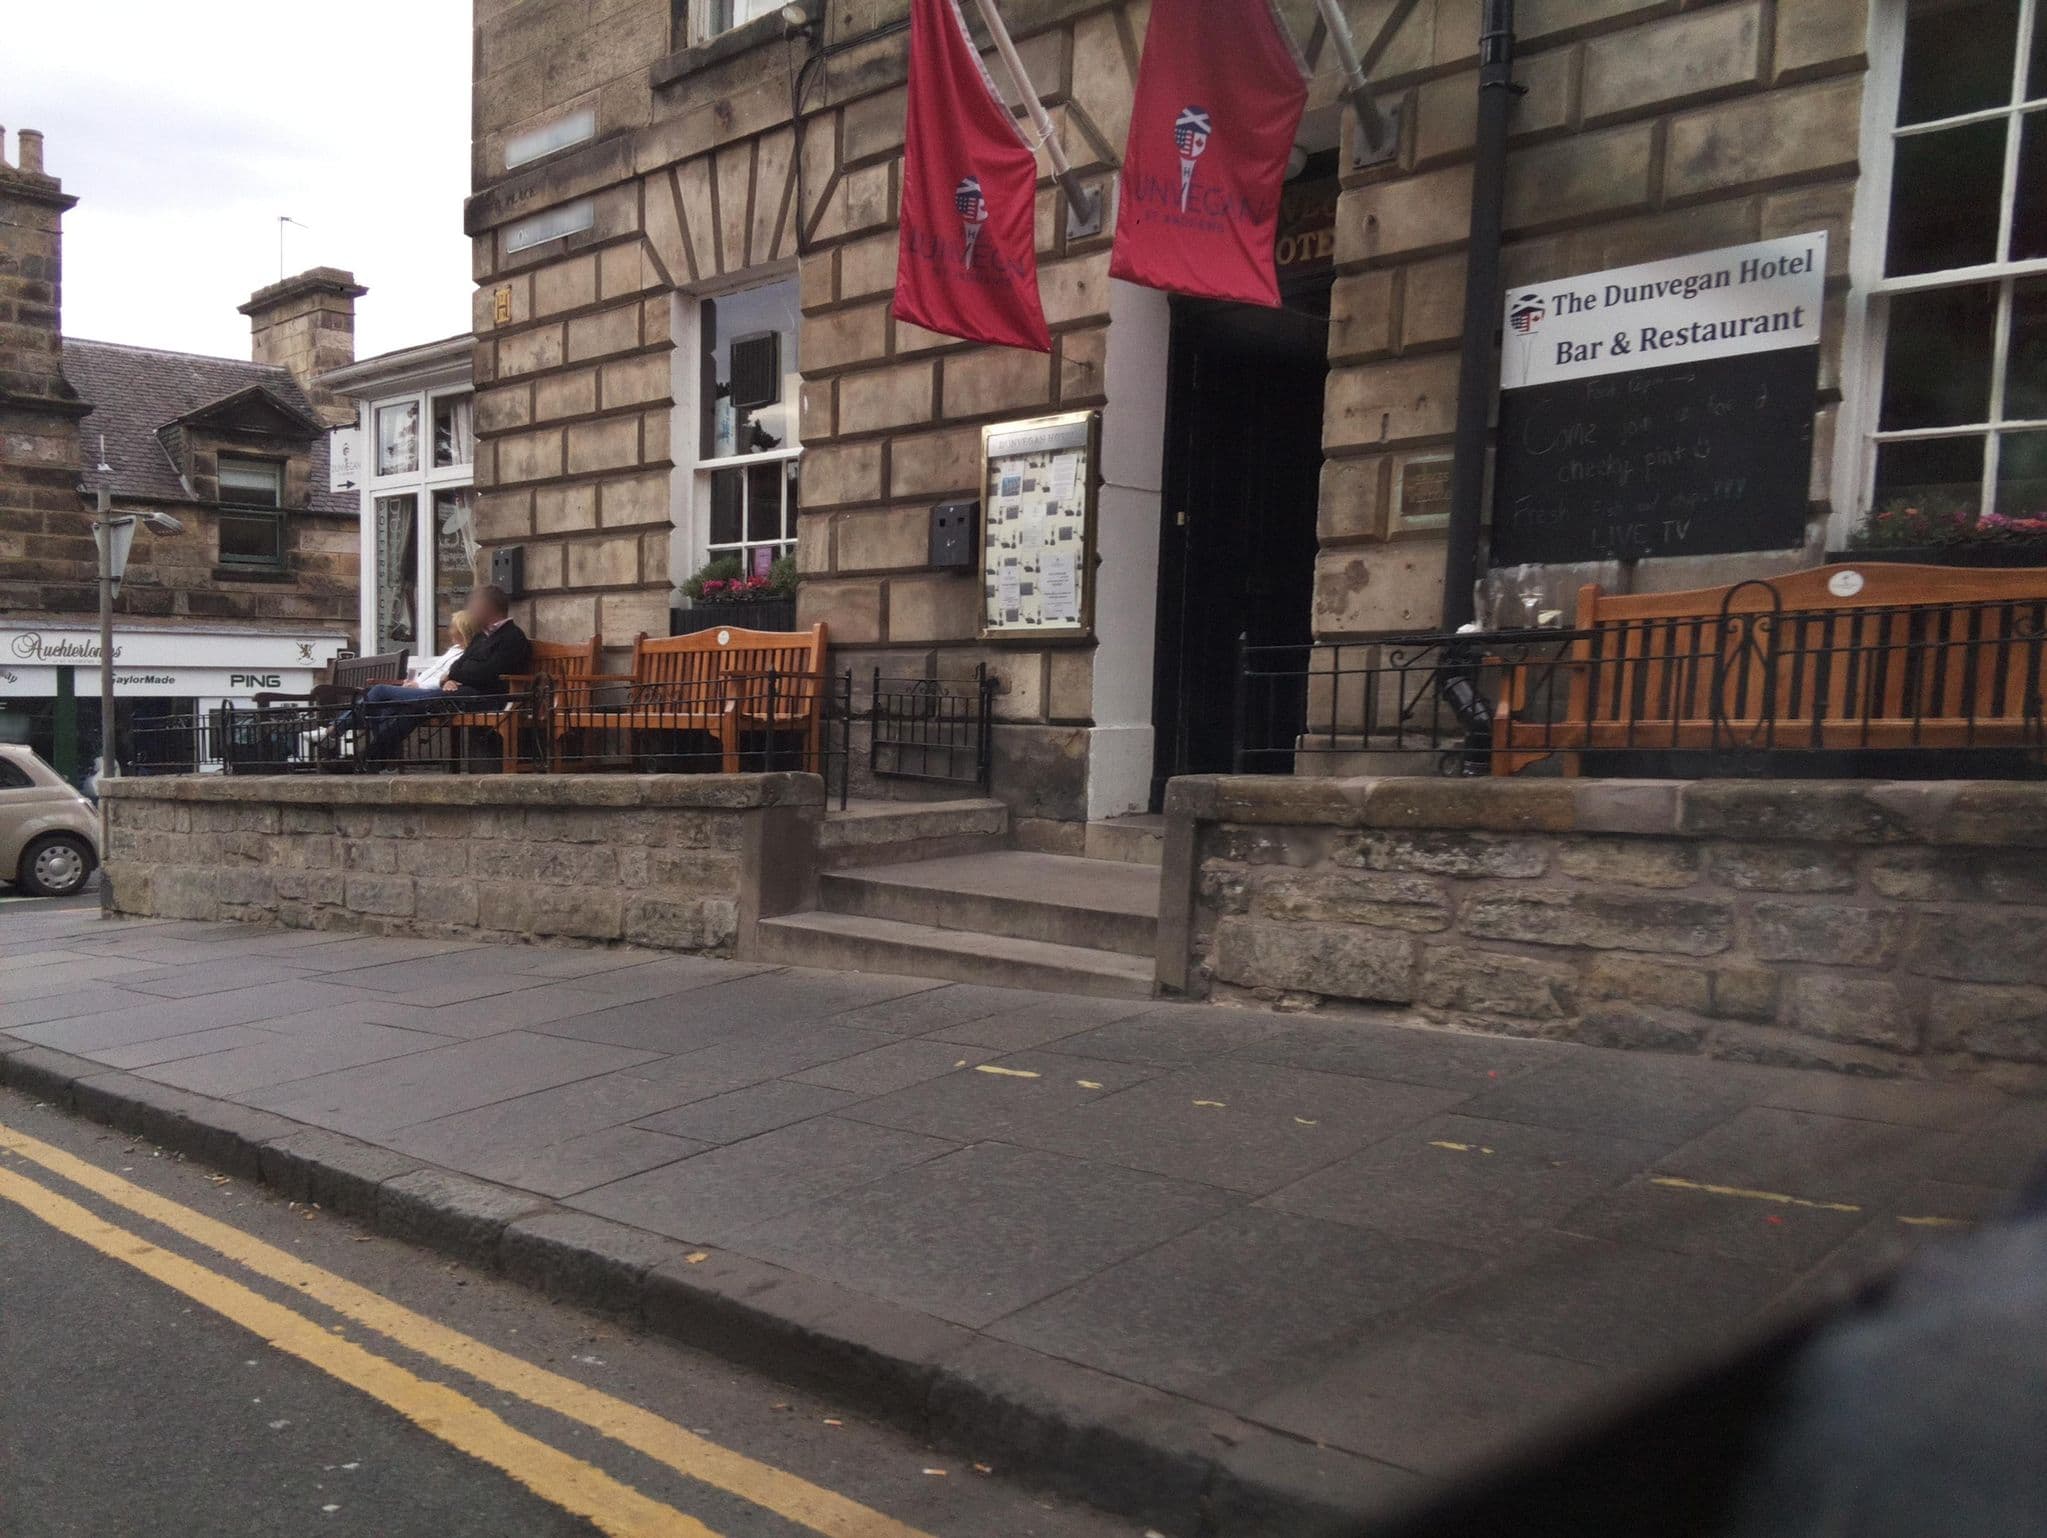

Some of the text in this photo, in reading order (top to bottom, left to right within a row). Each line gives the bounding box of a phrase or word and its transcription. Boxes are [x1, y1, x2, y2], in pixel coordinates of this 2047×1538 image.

[1551, 248, 1814, 317] The Dunvegan Hotel
[1555, 304, 1807, 366] Bar & Restaurant
[1592, 519, 1692, 550] LIVE TV
[230, 674, 281, 688] PING
